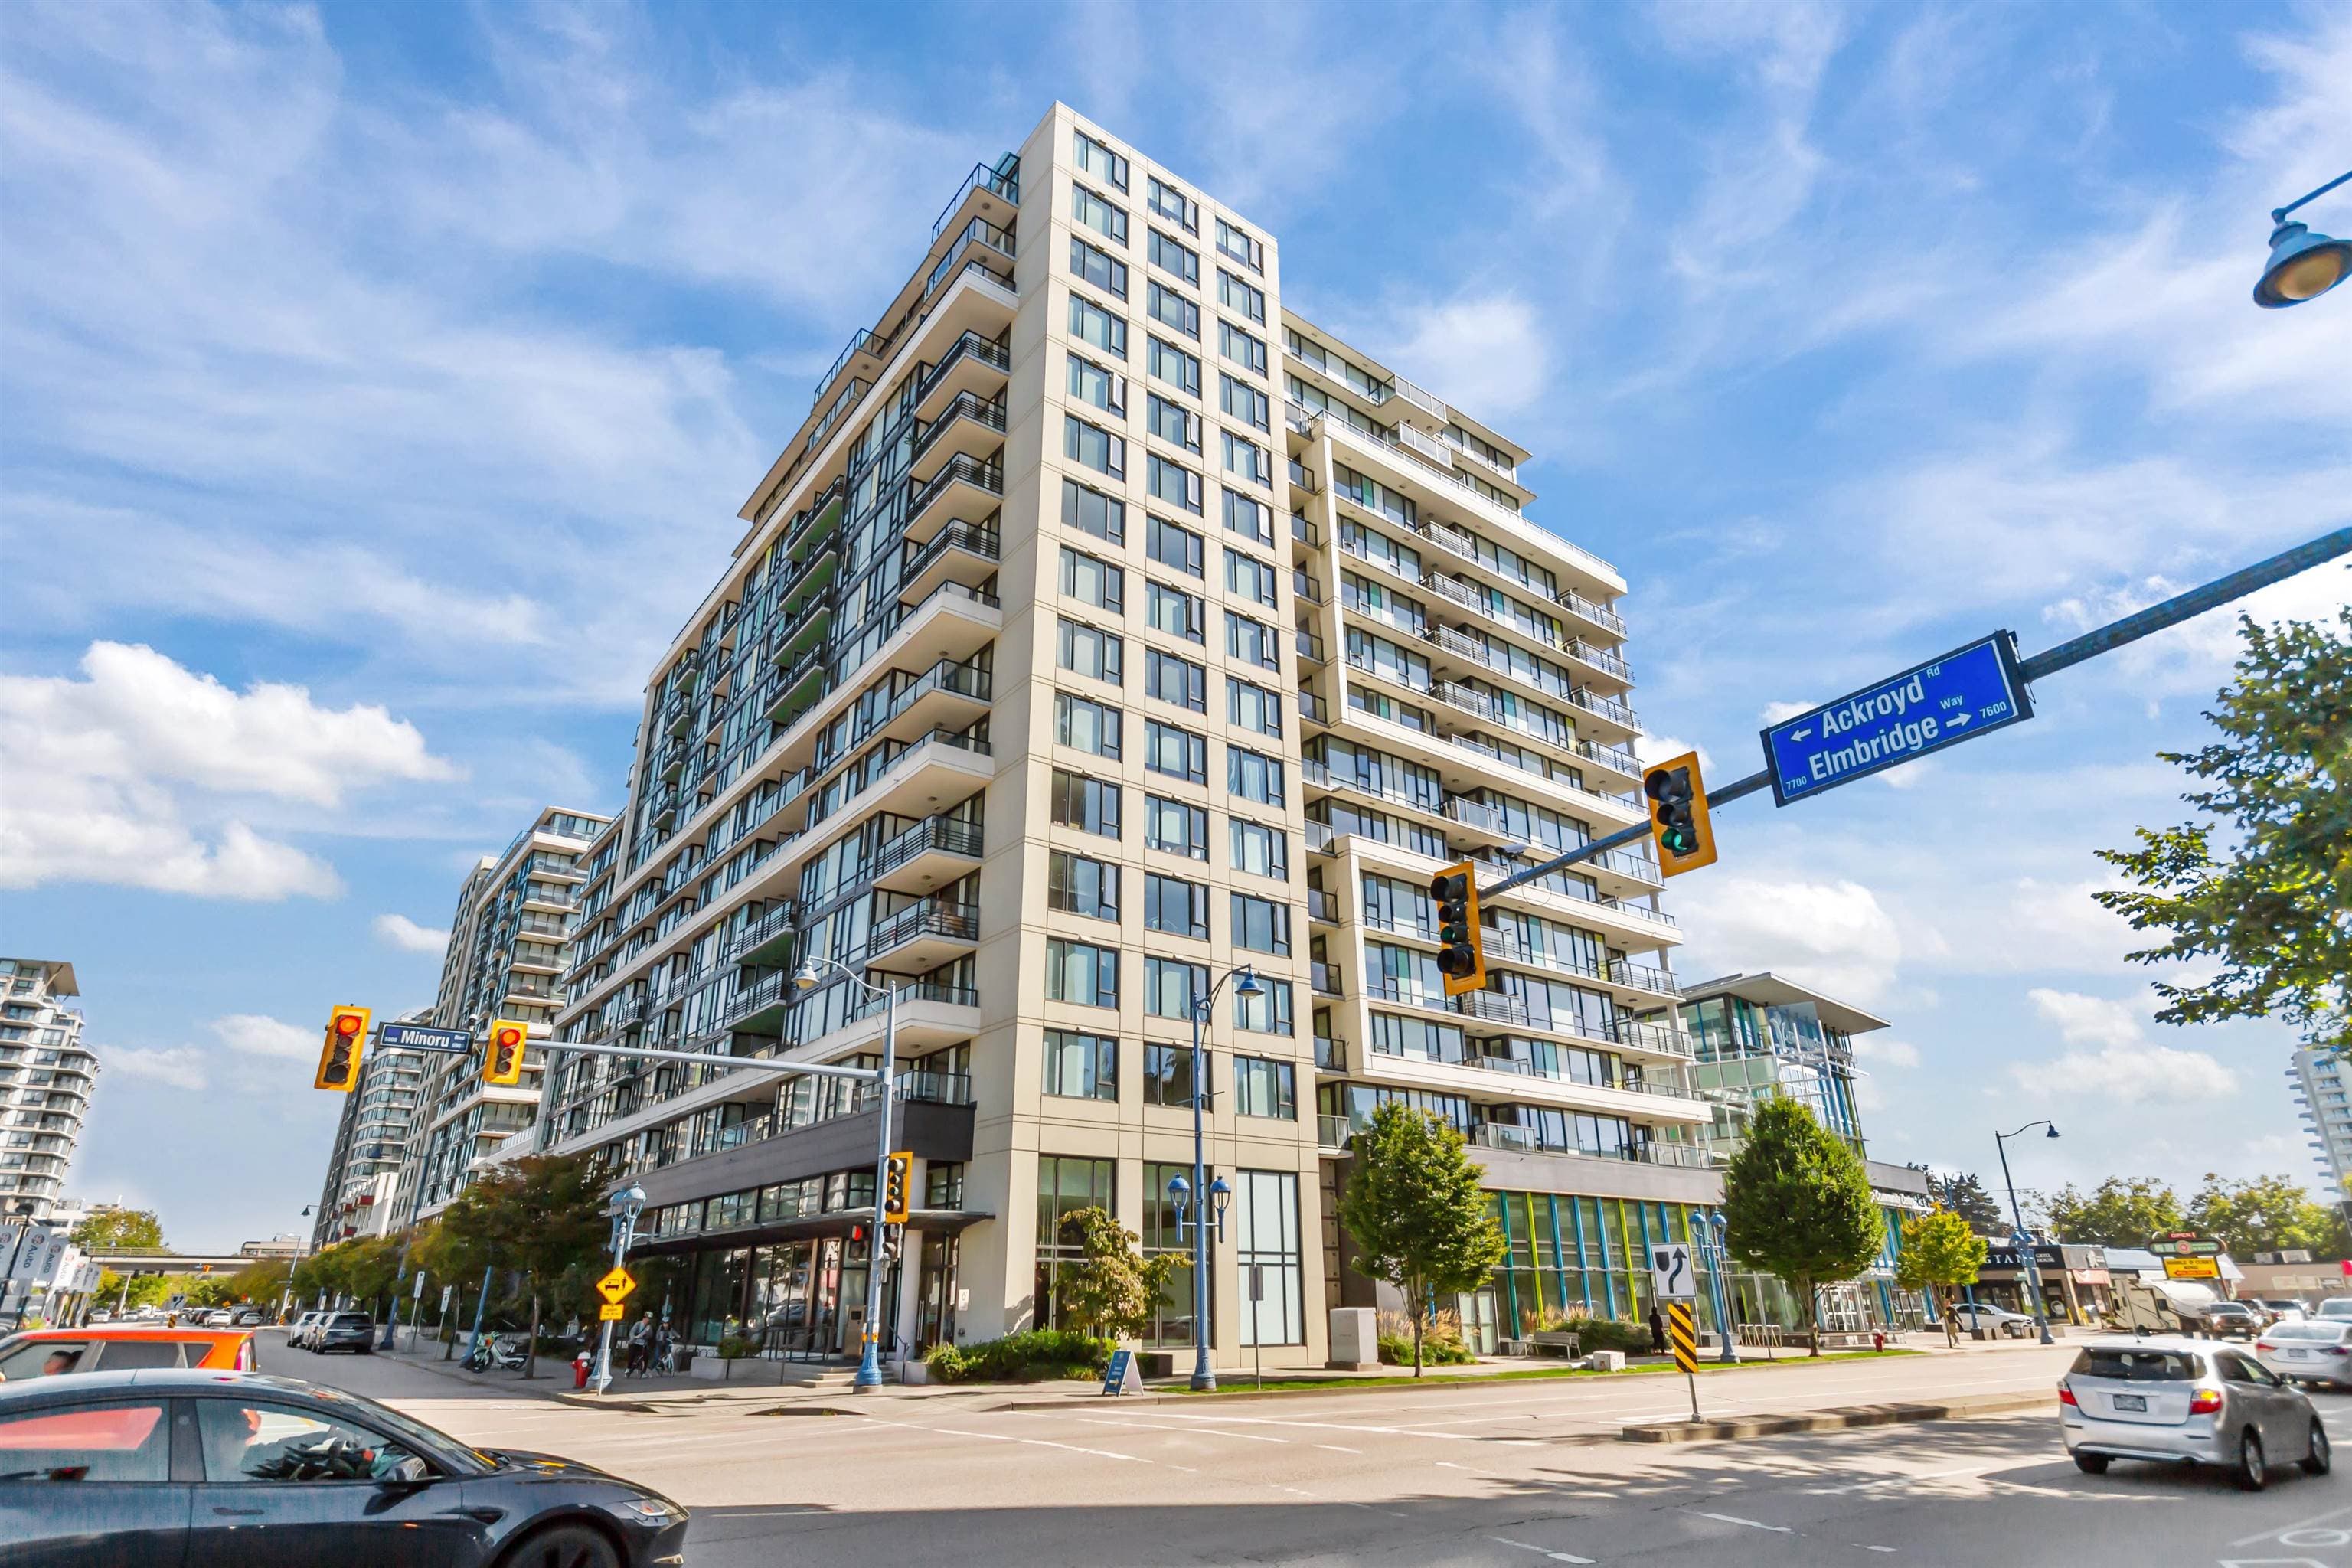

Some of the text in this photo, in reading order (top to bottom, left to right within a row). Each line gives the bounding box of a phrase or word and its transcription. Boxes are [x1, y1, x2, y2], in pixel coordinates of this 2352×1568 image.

[1821, 665, 1940, 738] Ackroyd Rd
[1785, 694, 2007, 790] 7700 Elmbridge Way 7600
[400, 1030, 450, 1047] Minoru
[23, 1244, 38, 1269] Auto
[44, 1253, 55, 1274] Auto
